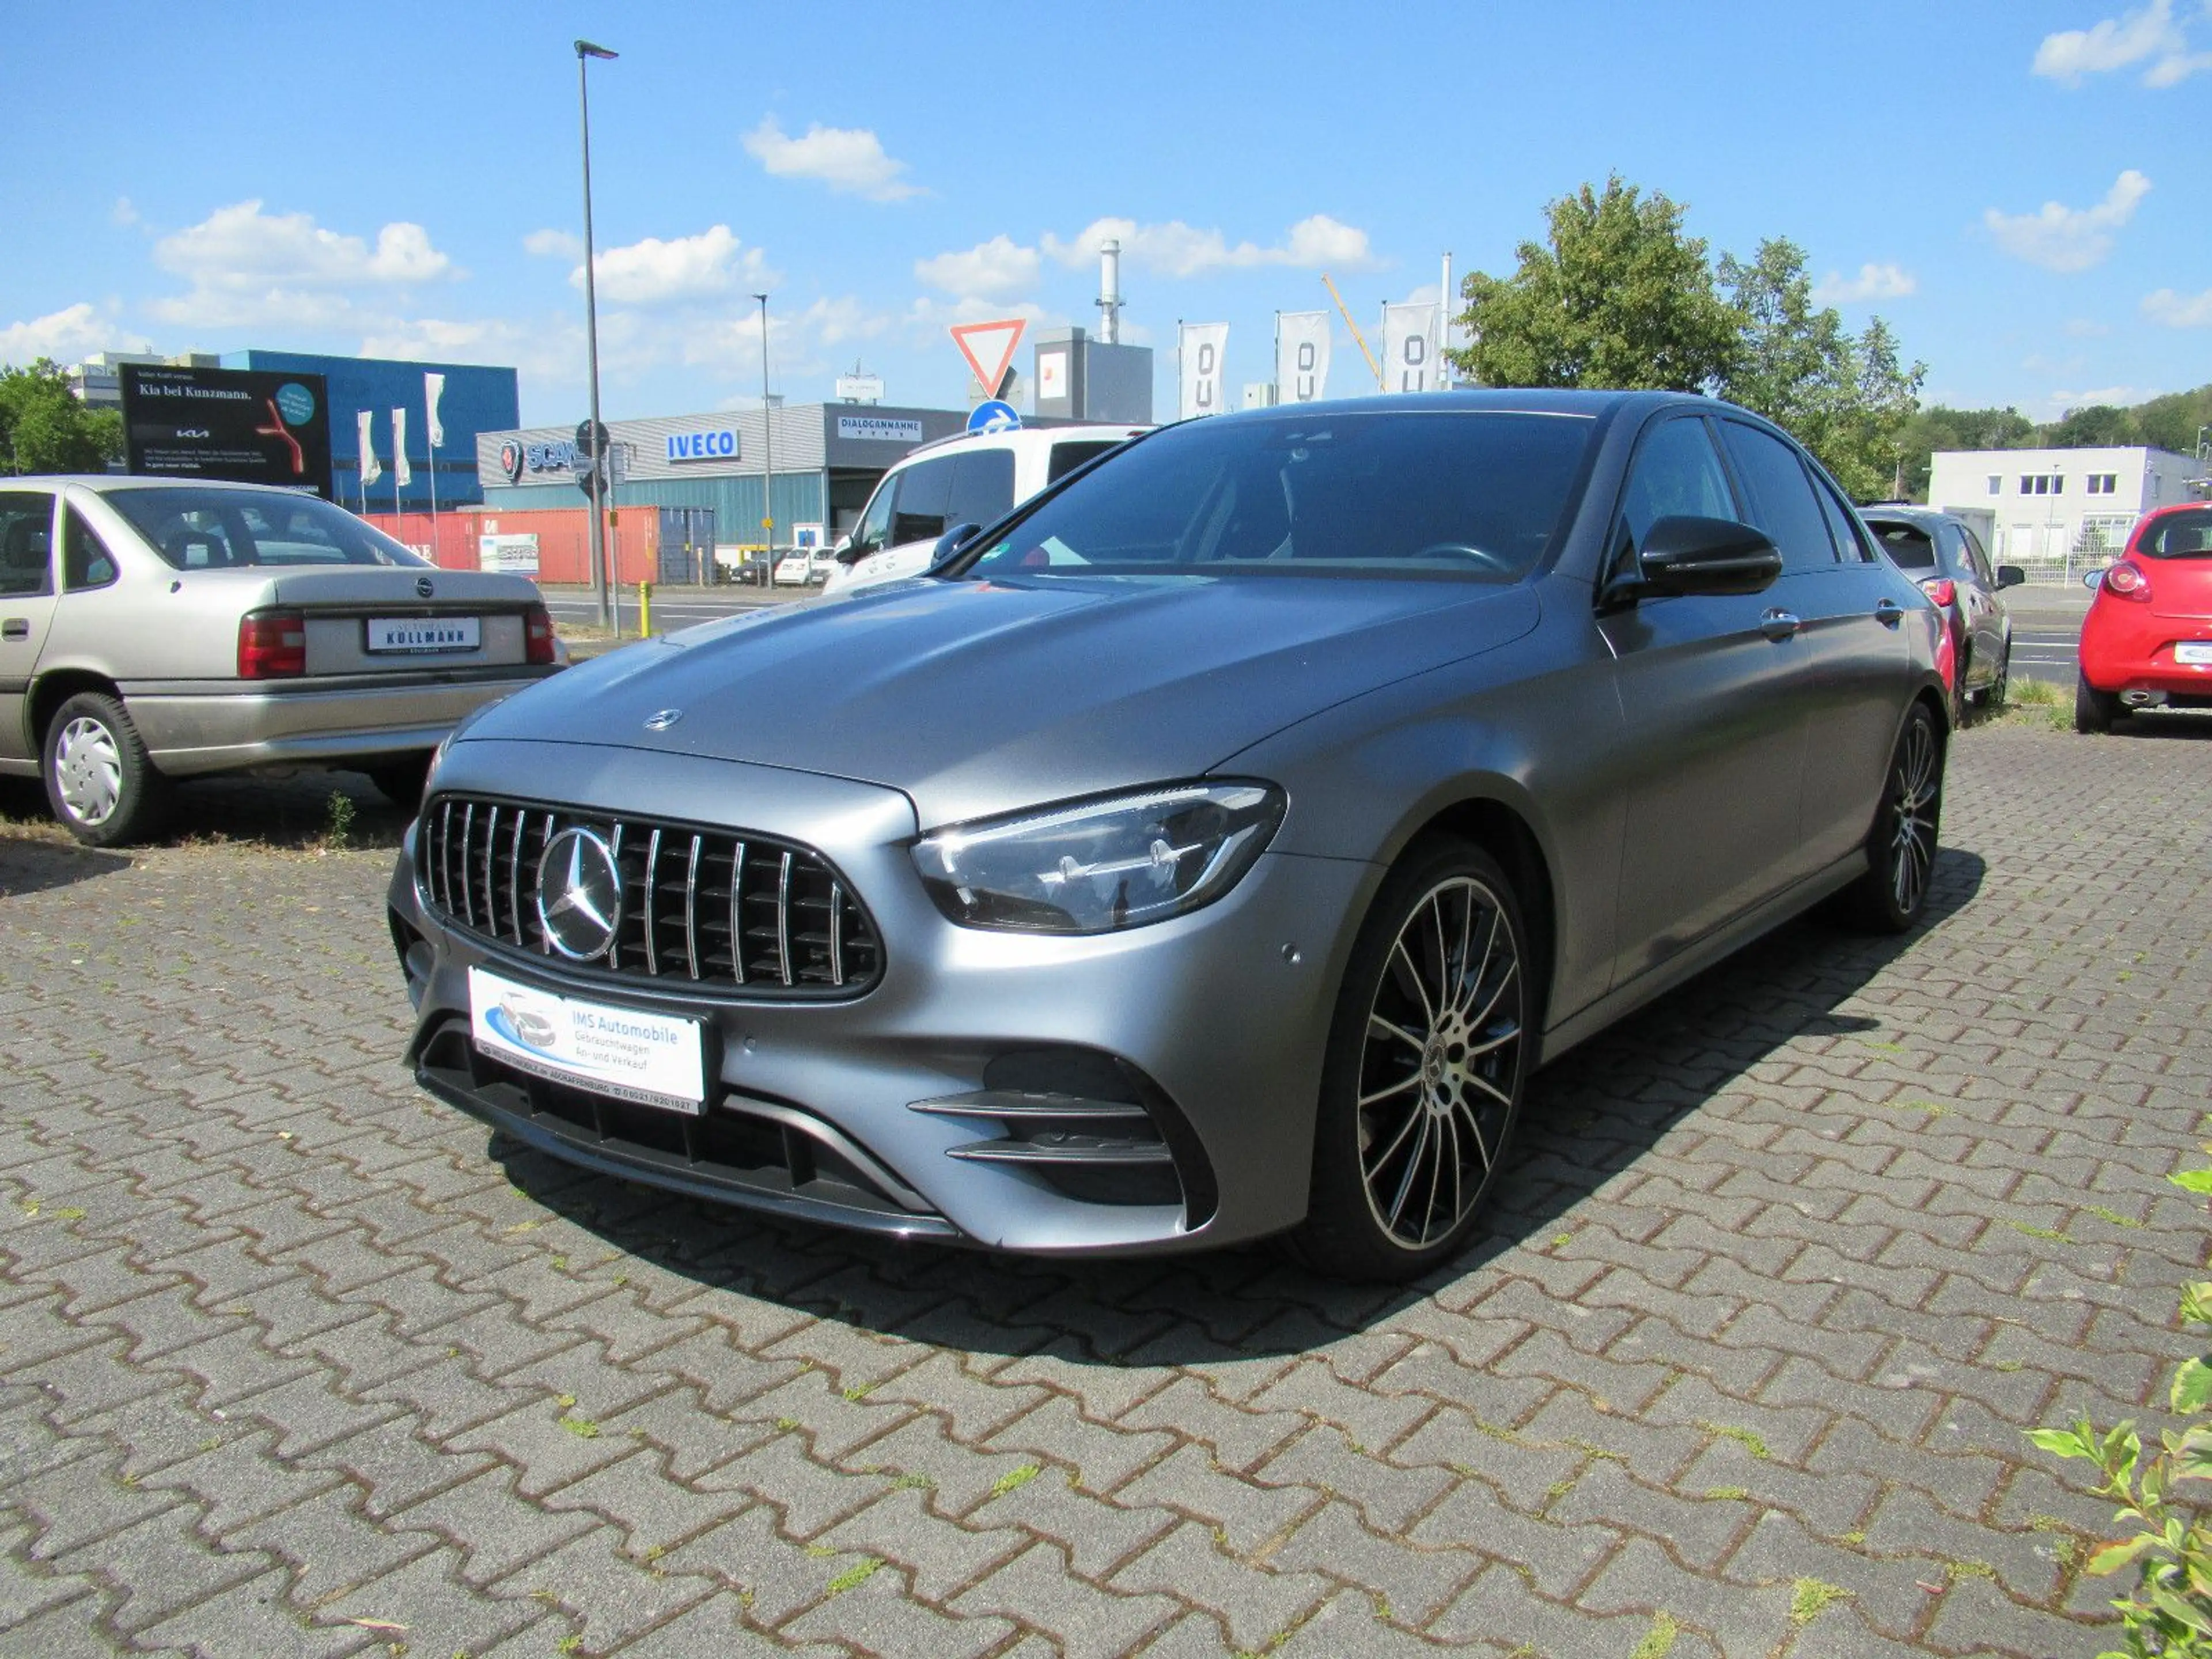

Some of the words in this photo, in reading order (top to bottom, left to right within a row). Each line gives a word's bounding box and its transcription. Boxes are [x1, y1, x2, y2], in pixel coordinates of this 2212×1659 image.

[139, 384, 160, 395] Kia
[164, 385, 181, 396] bei
[185, 387, 252, 400] Kunzmann.
[529, 441, 576, 469] SCAN
[668, 431, 733, 458] IVECO
[573, 1010, 594, 1028] IMS
[598, 1017, 679, 1045] Automobile
[575, 1030, 650, 1055] Gebrauchtwagen
[593, 1051, 609, 1063] und
[611, 1054, 648, 1070] Verkauf
